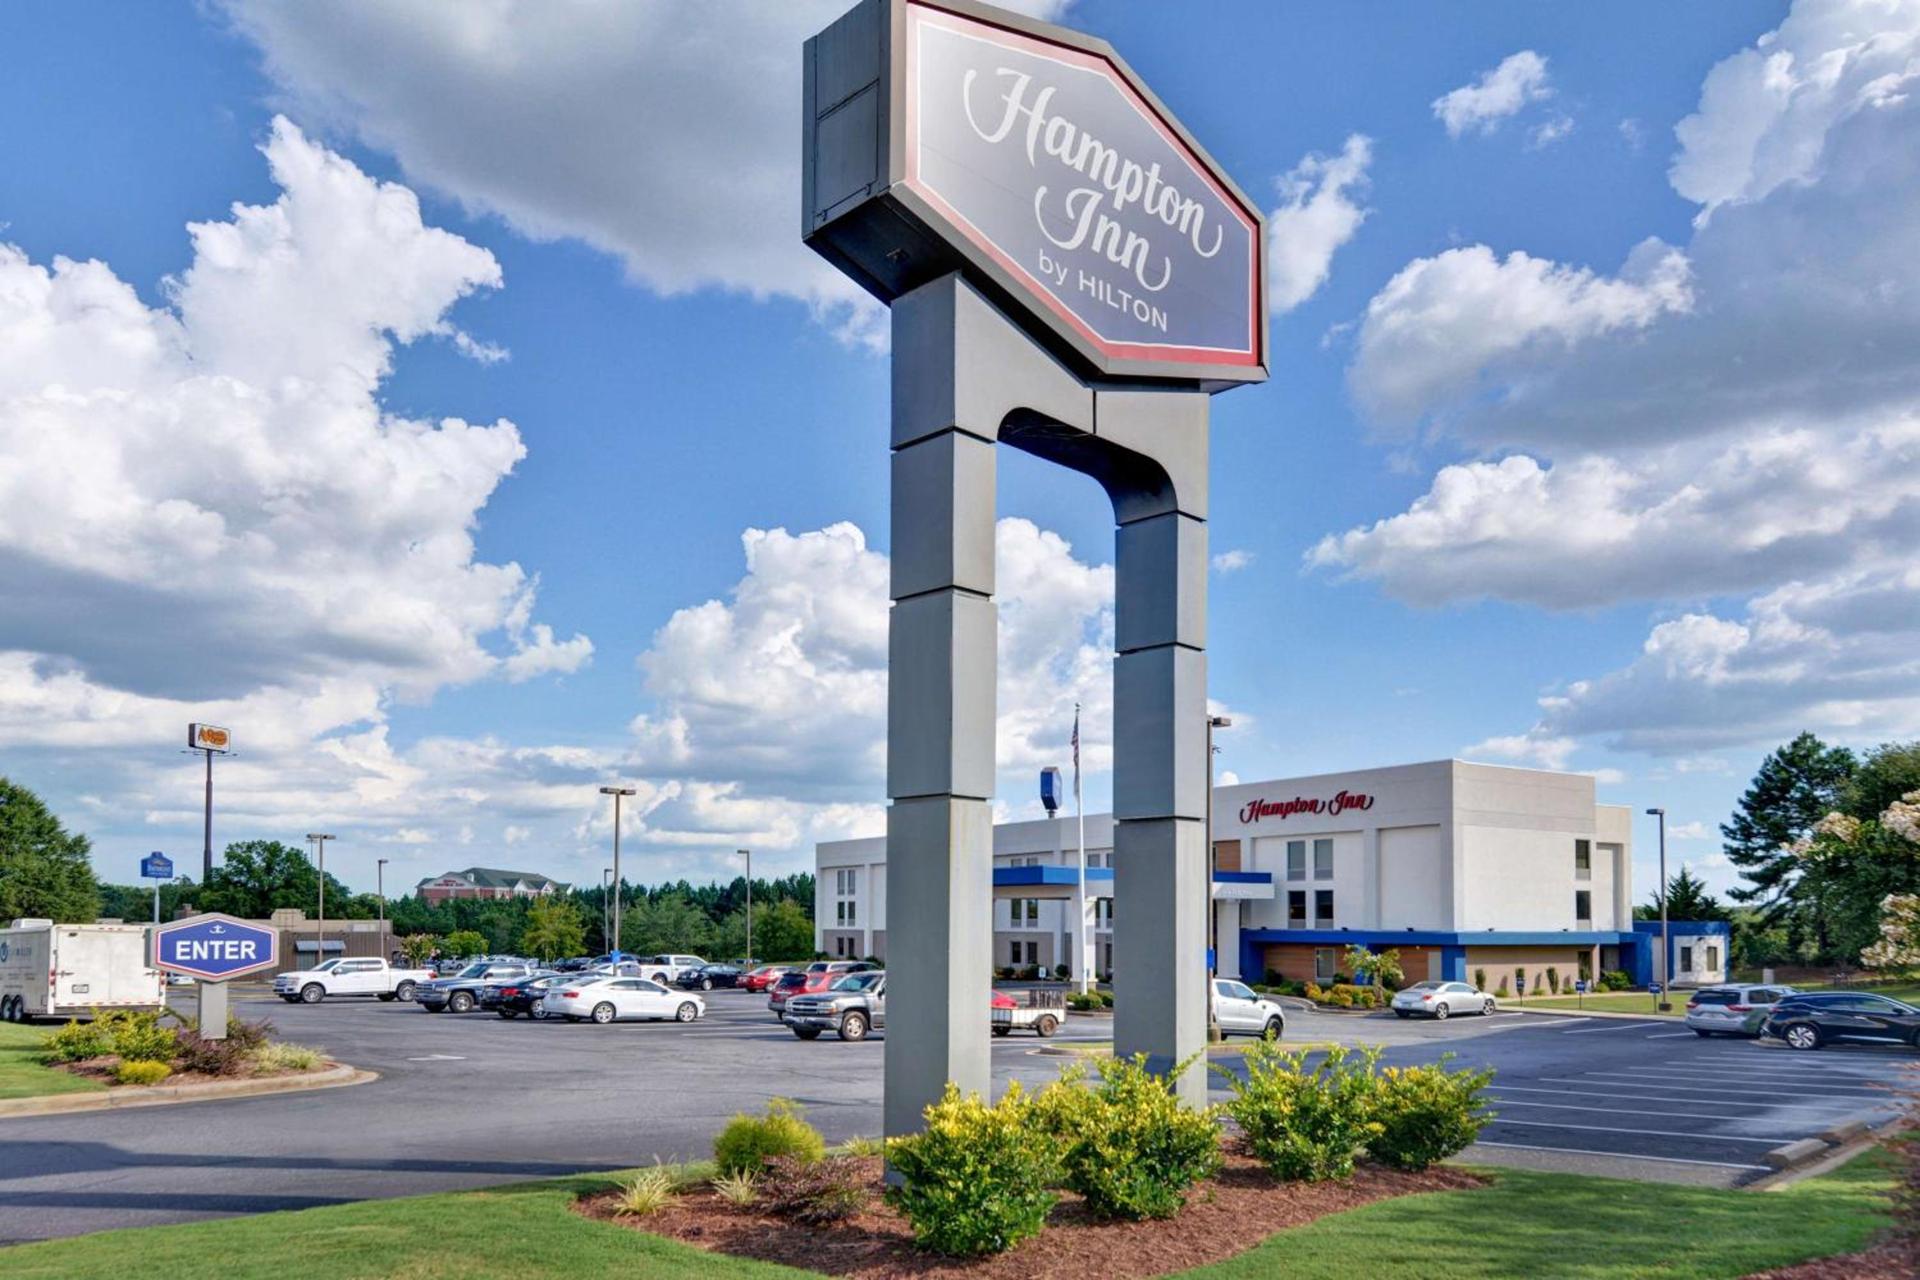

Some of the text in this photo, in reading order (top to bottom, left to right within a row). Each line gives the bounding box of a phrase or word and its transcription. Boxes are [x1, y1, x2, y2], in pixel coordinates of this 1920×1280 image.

[963, 67, 1222, 258] Hampton
[1035, 185, 1171, 291] Inn
[1039, 249, 1167, 332] by HILTON
[1239, 790, 1374, 824] Hampton Inn
[175, 940, 256, 960] ENTER
